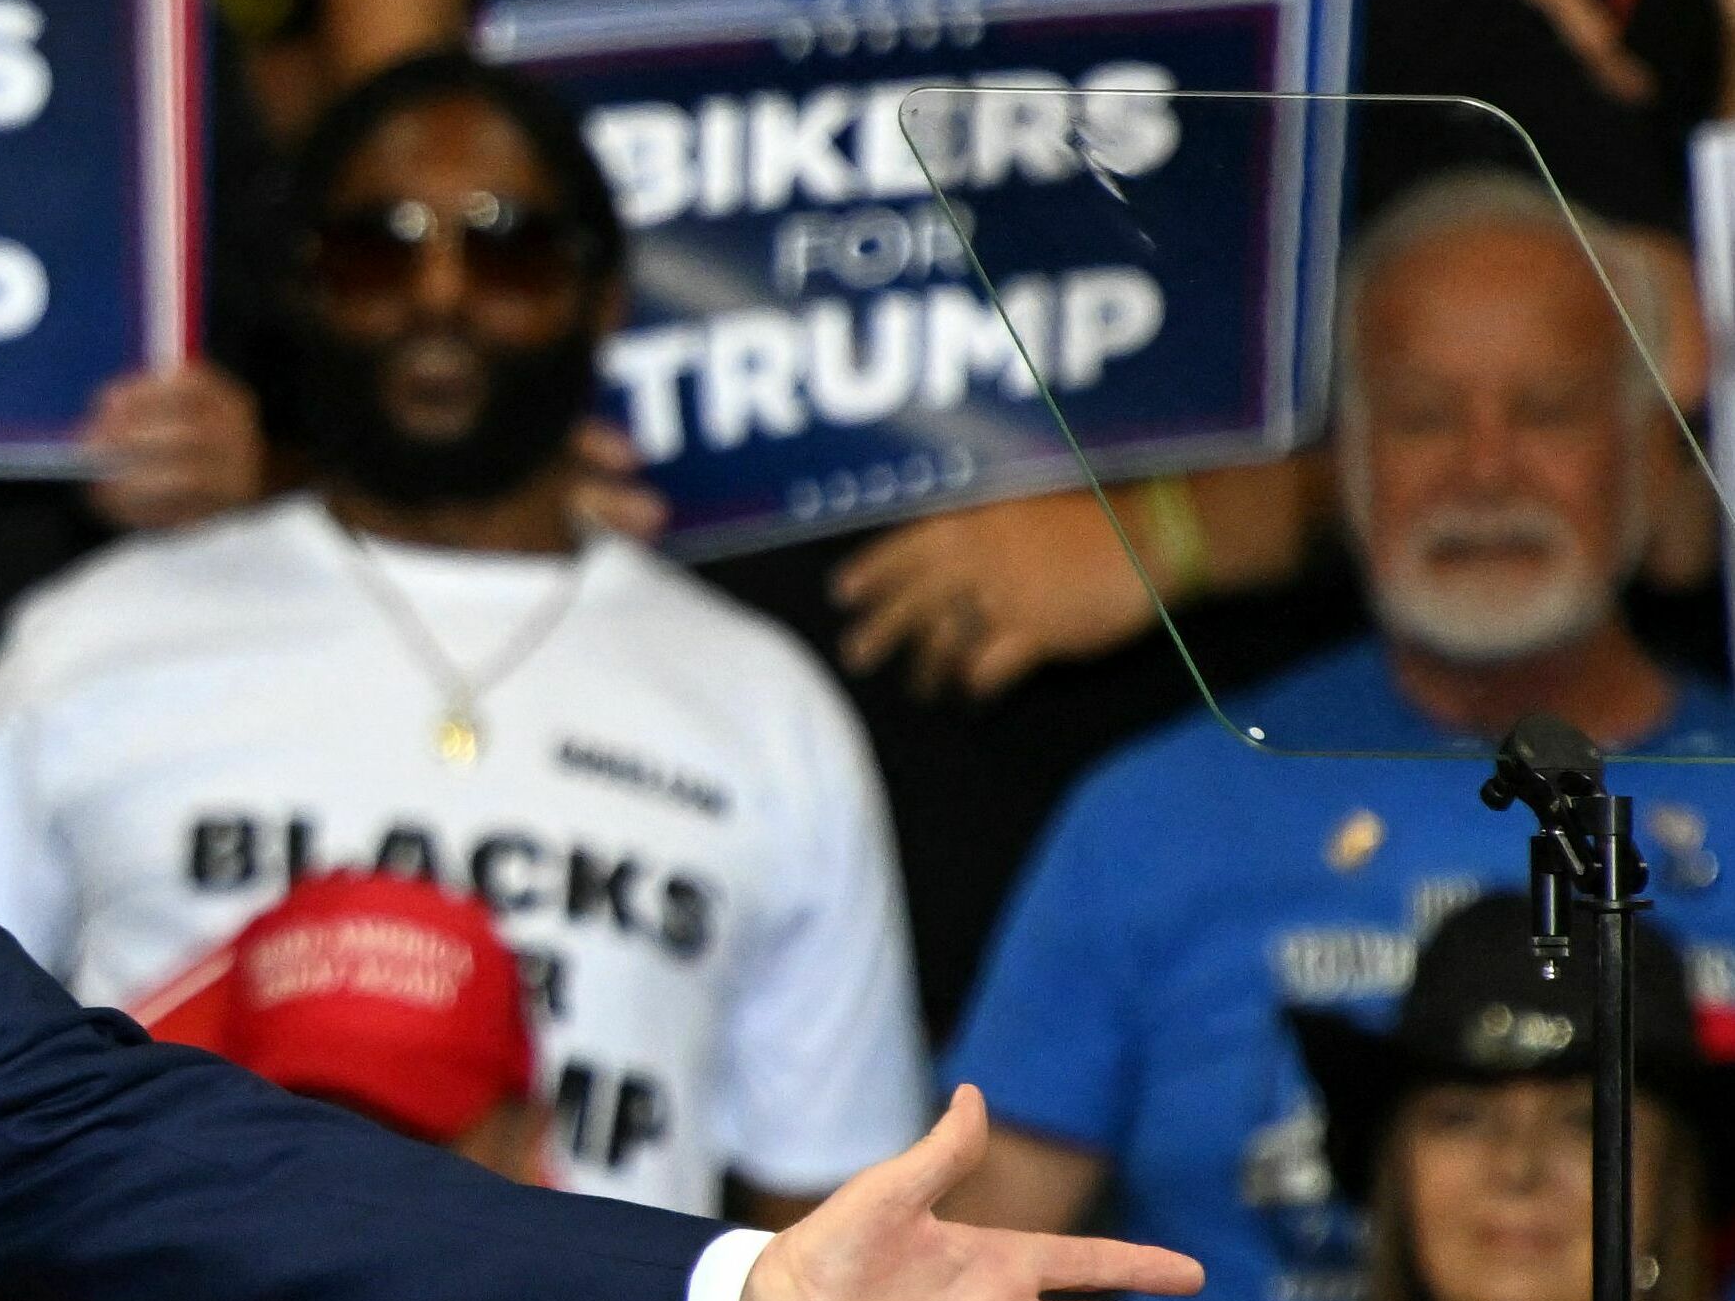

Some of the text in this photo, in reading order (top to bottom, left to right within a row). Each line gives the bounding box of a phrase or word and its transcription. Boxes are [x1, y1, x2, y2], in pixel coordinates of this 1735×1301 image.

[585, 61, 1181, 227] BIKERS
[777, 205, 975, 295] FOR
[597, 267, 1165, 463] TRUMP
